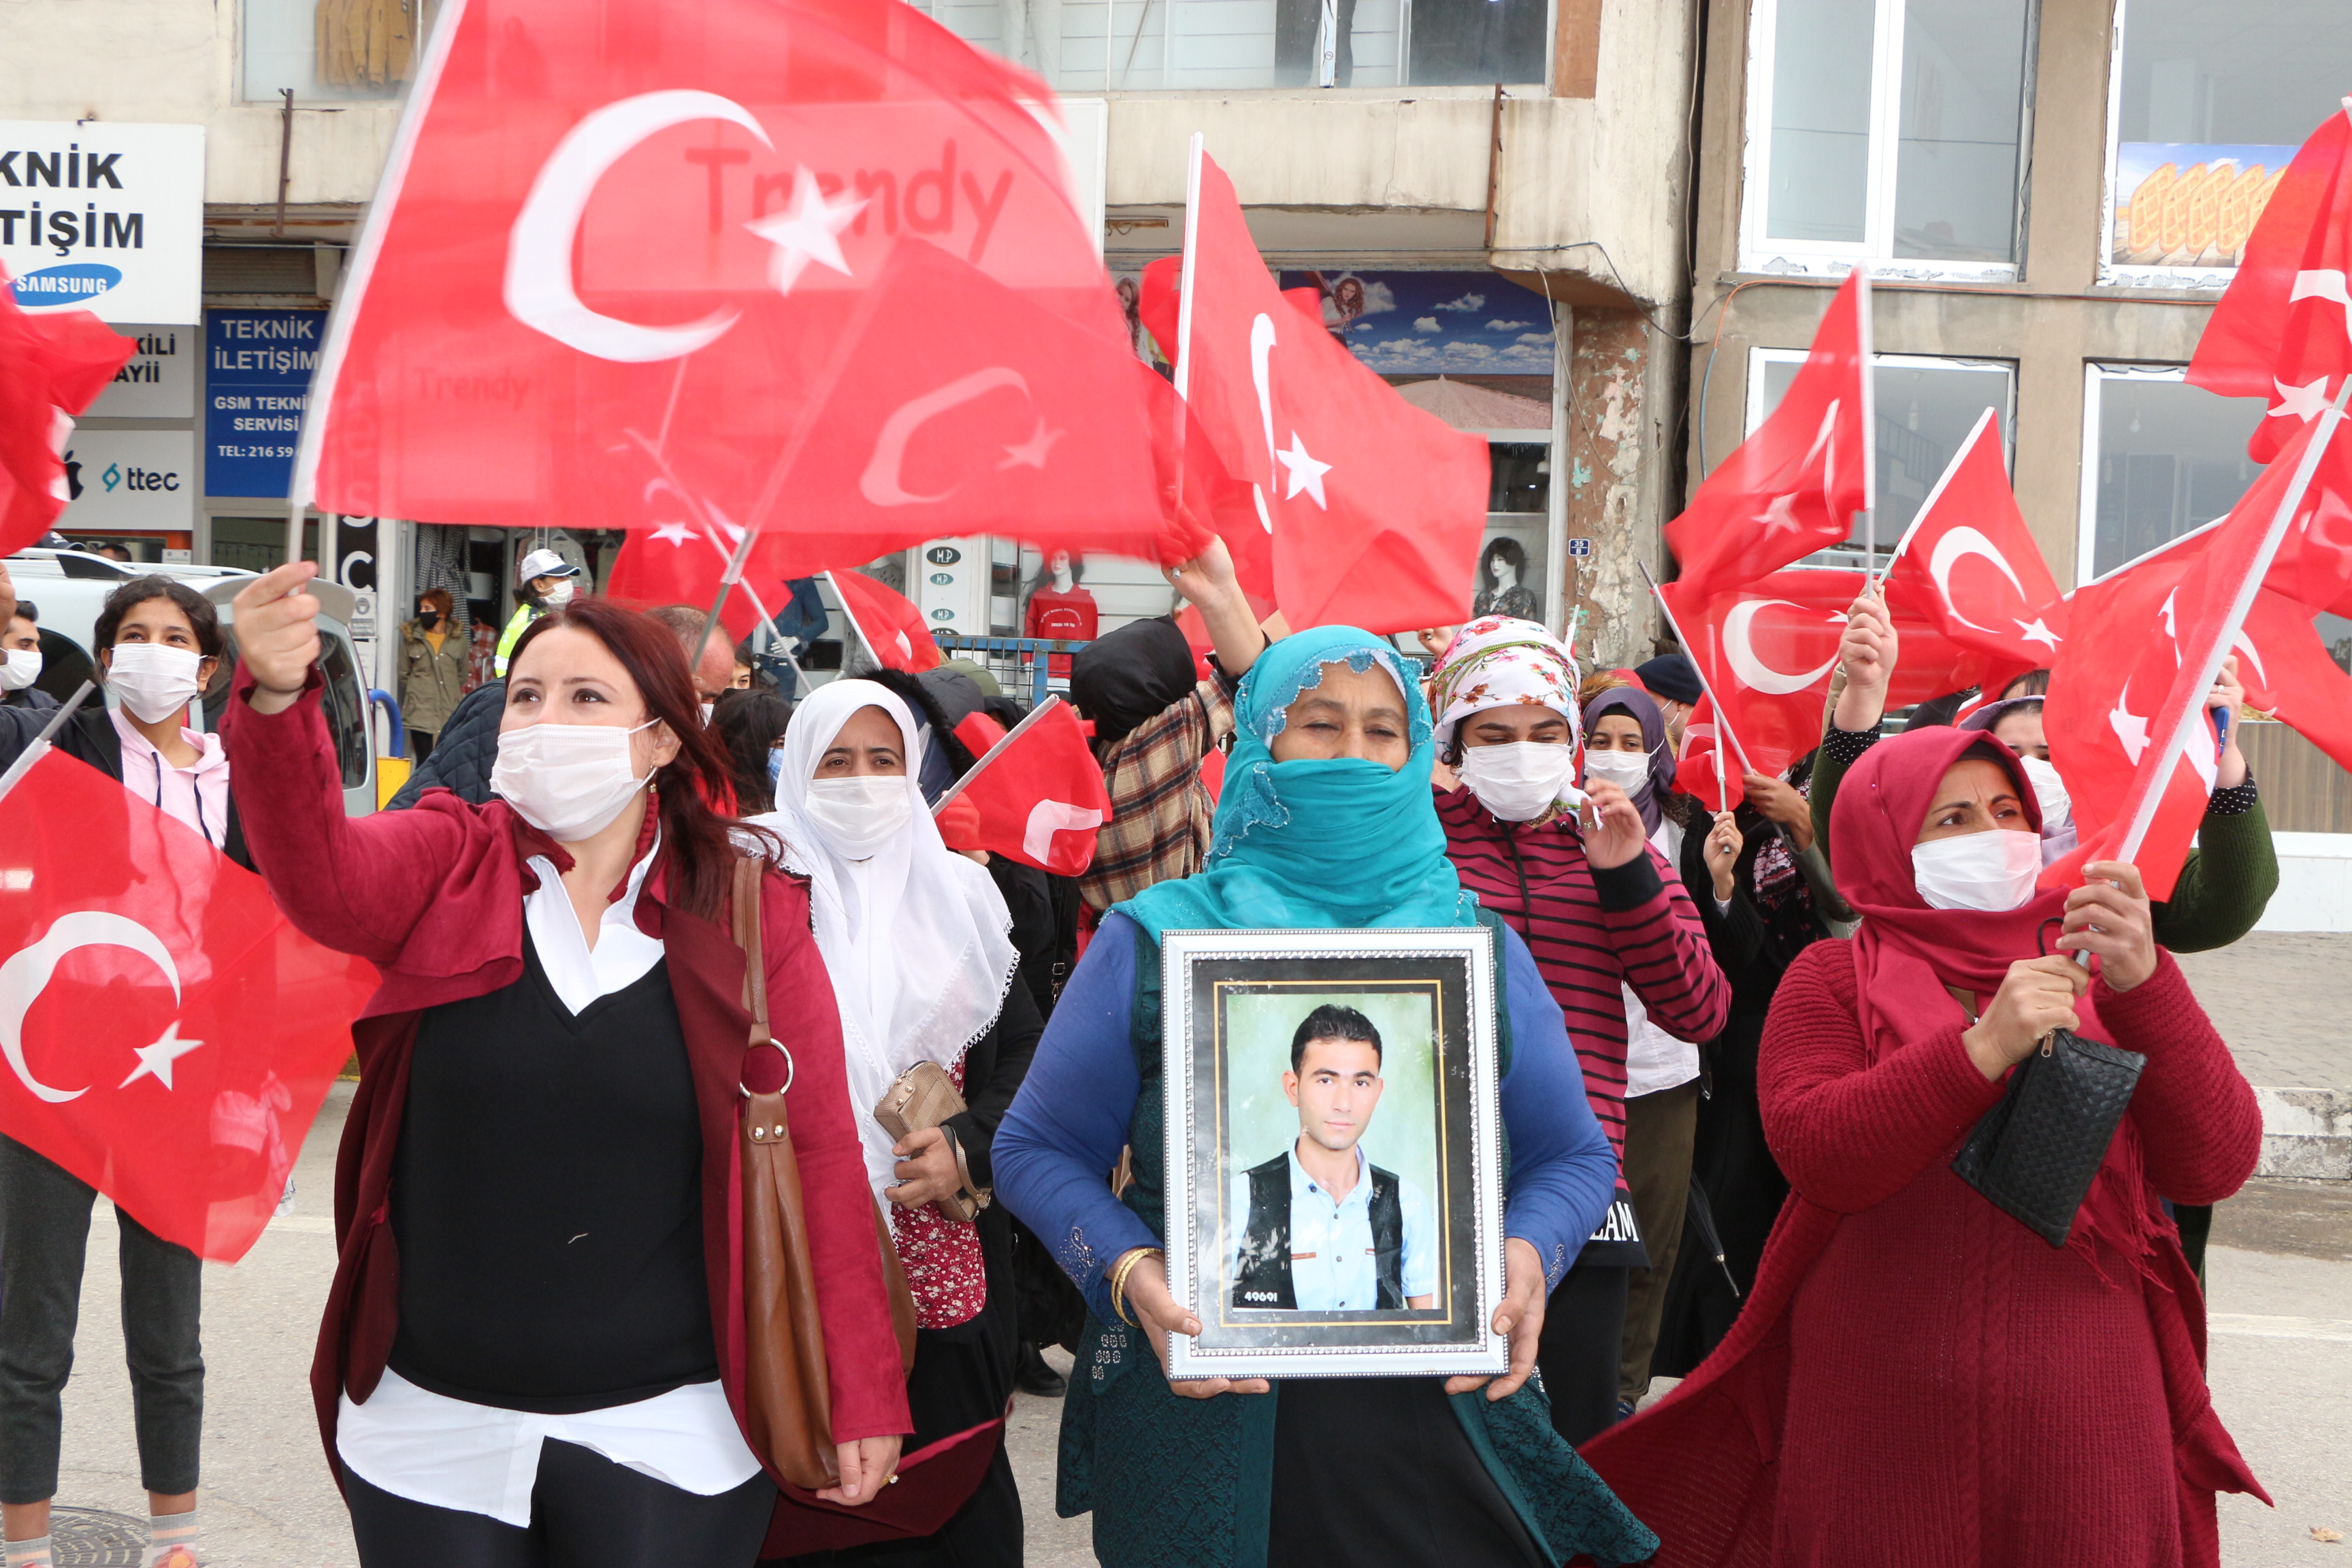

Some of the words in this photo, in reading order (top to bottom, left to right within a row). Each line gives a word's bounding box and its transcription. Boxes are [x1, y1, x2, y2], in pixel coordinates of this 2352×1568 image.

[16, 276, 108, 294] SAMSUNG
[221, 316, 314, 338] TEKNİK
[215, 346, 319, 374] İLETİŞİM
[214, 396, 251, 410] GSM
[255, 395, 312, 410] TEKNİ
[233, 415, 299, 431] SERVİSİ
[218, 445, 246, 457] TEL:
[248, 446, 274, 457] 216
[276, 446, 294, 457] 59
[127, 468, 180, 491] ttec
[1244, 1291, 1278, 1302] 49691
